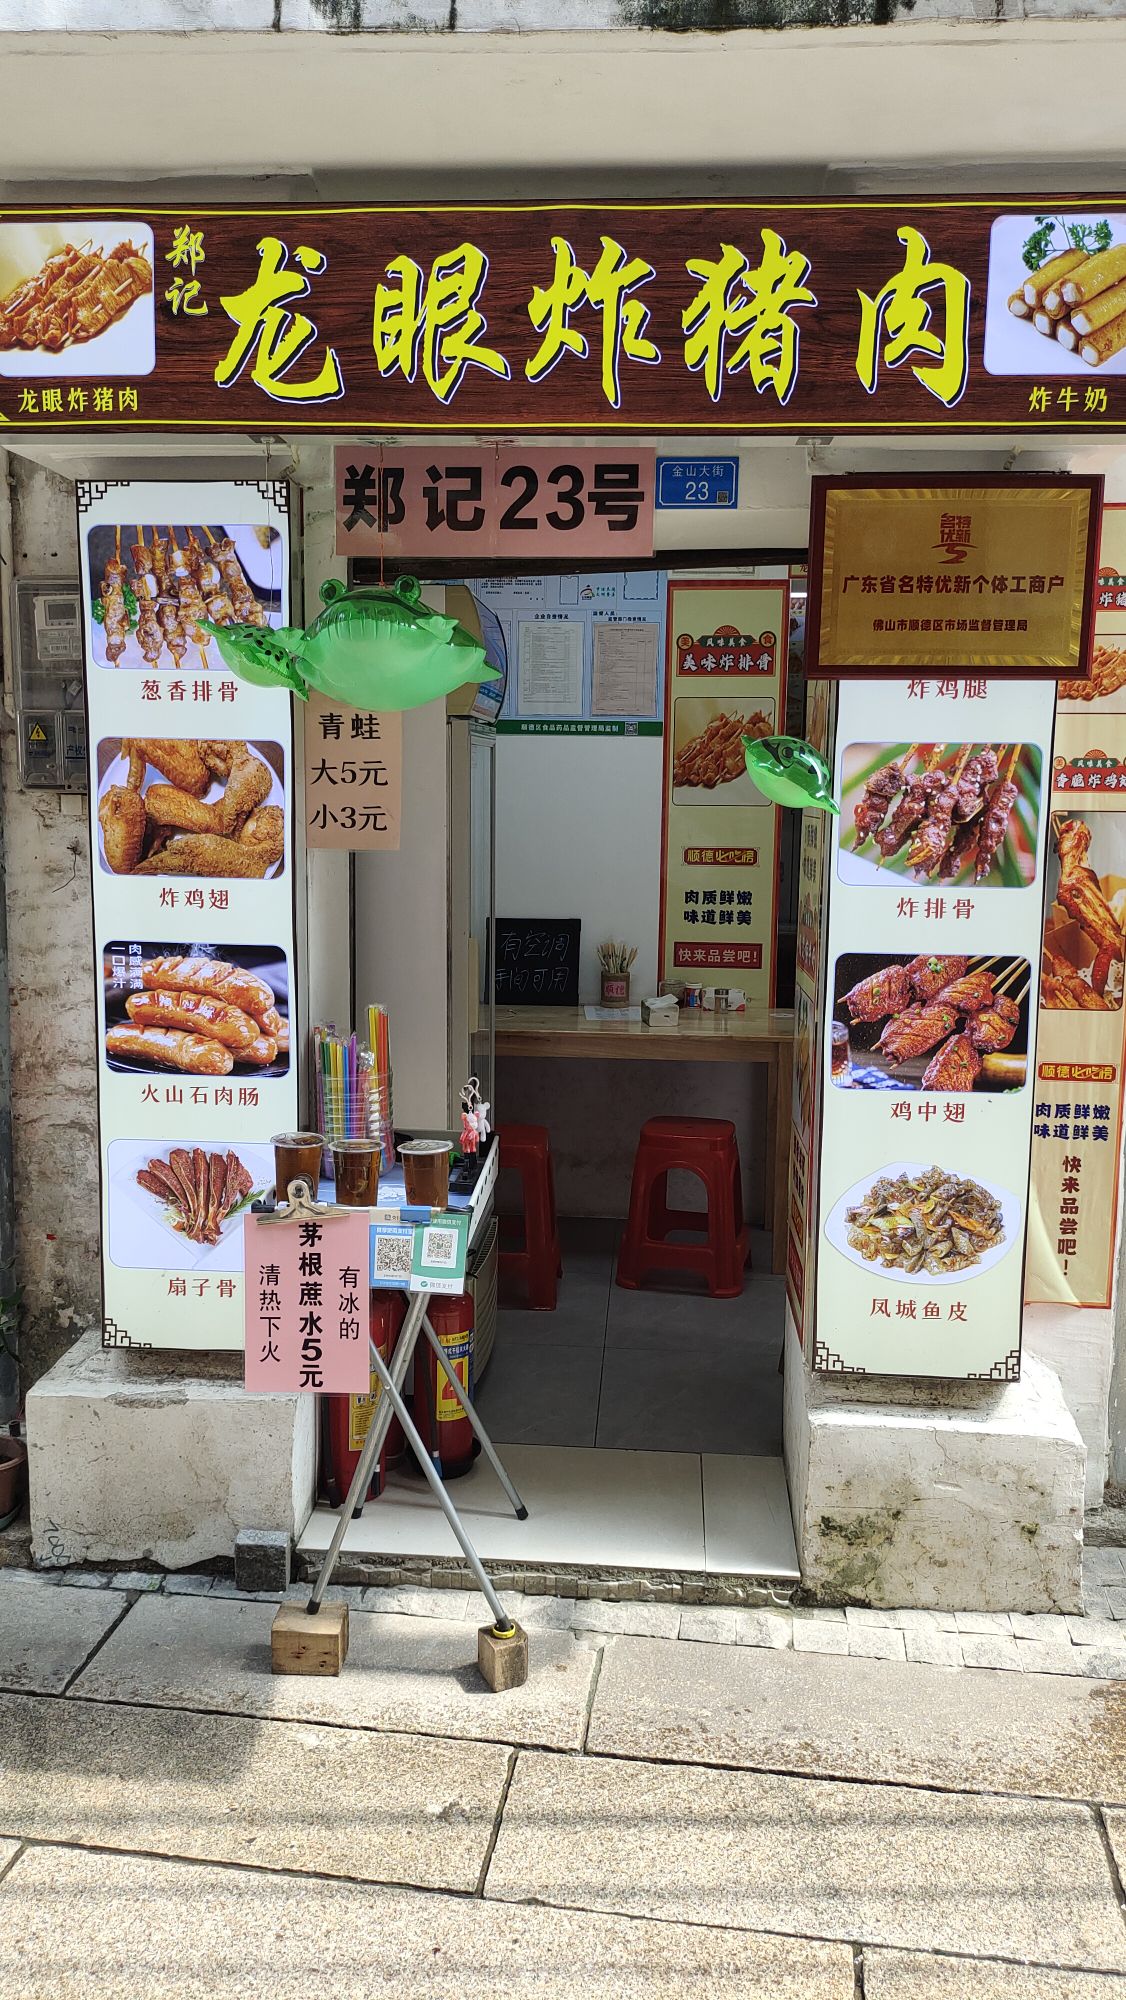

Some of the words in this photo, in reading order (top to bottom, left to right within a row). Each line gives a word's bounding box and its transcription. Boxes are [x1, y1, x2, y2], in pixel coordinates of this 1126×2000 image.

[166, 224, 208, 317] 郑记
[214, 225, 971, 408] 龙眼炸猪肉
[17, 386, 139, 413] 龙眼炸猪肉
[1028, 386, 1108, 413] 炸牛奶
[672, 465, 724, 477] 金山大街
[343, 463, 645, 532] 郑记23号
[685, 481, 709, 500] 23
[843, 575, 1064, 595] 广东省名特优新个体工商户
[873, 619, 1028, 632] 佛山市顺德区市场监督管理局
[706, 637, 748, 647] 风味美食
[682, 653, 772, 671] 美味炸排骨
[141, 680, 239, 702] 葱香排骨
[907, 680, 987, 699] 炸鸡腿
[319, 713, 381, 740] 青蛙
[311, 758, 389, 786] 大5元
[309, 805, 388, 831] 小3元
[159, 888, 230, 909] 炸鸡翅
[684, 890, 753, 905] 肉质鲜嫩
[897, 897, 975, 920] 炸排骨
[683, 909, 752, 925] 味道鲜美
[501, 930, 570, 961] 有空调
[679, 948, 758, 963] 快来品尝吧!
[111, 946, 126, 989] 一口爆汁
[128, 943, 144, 989] 肉感满满
[1041, 1064, 1113, 1081] 顺德必吃榜
[141, 1084, 259, 1106] 火山石肉肠
[890, 1101, 966, 1124] 鸡中翅
[1035, 1103, 1111, 1121] 肉质鲜嫩
[1033, 1123, 1109, 1141] 味道鲜美
[167, 1277, 236, 1298] 扇子骨
[259, 1264, 281, 1362] 清热下火
[299, 1222, 323, 1388] 茅根蔗水5元
[338, 1266, 360, 1340] 有冰的
[870, 1299, 968, 1322] 凤城鱼皮
